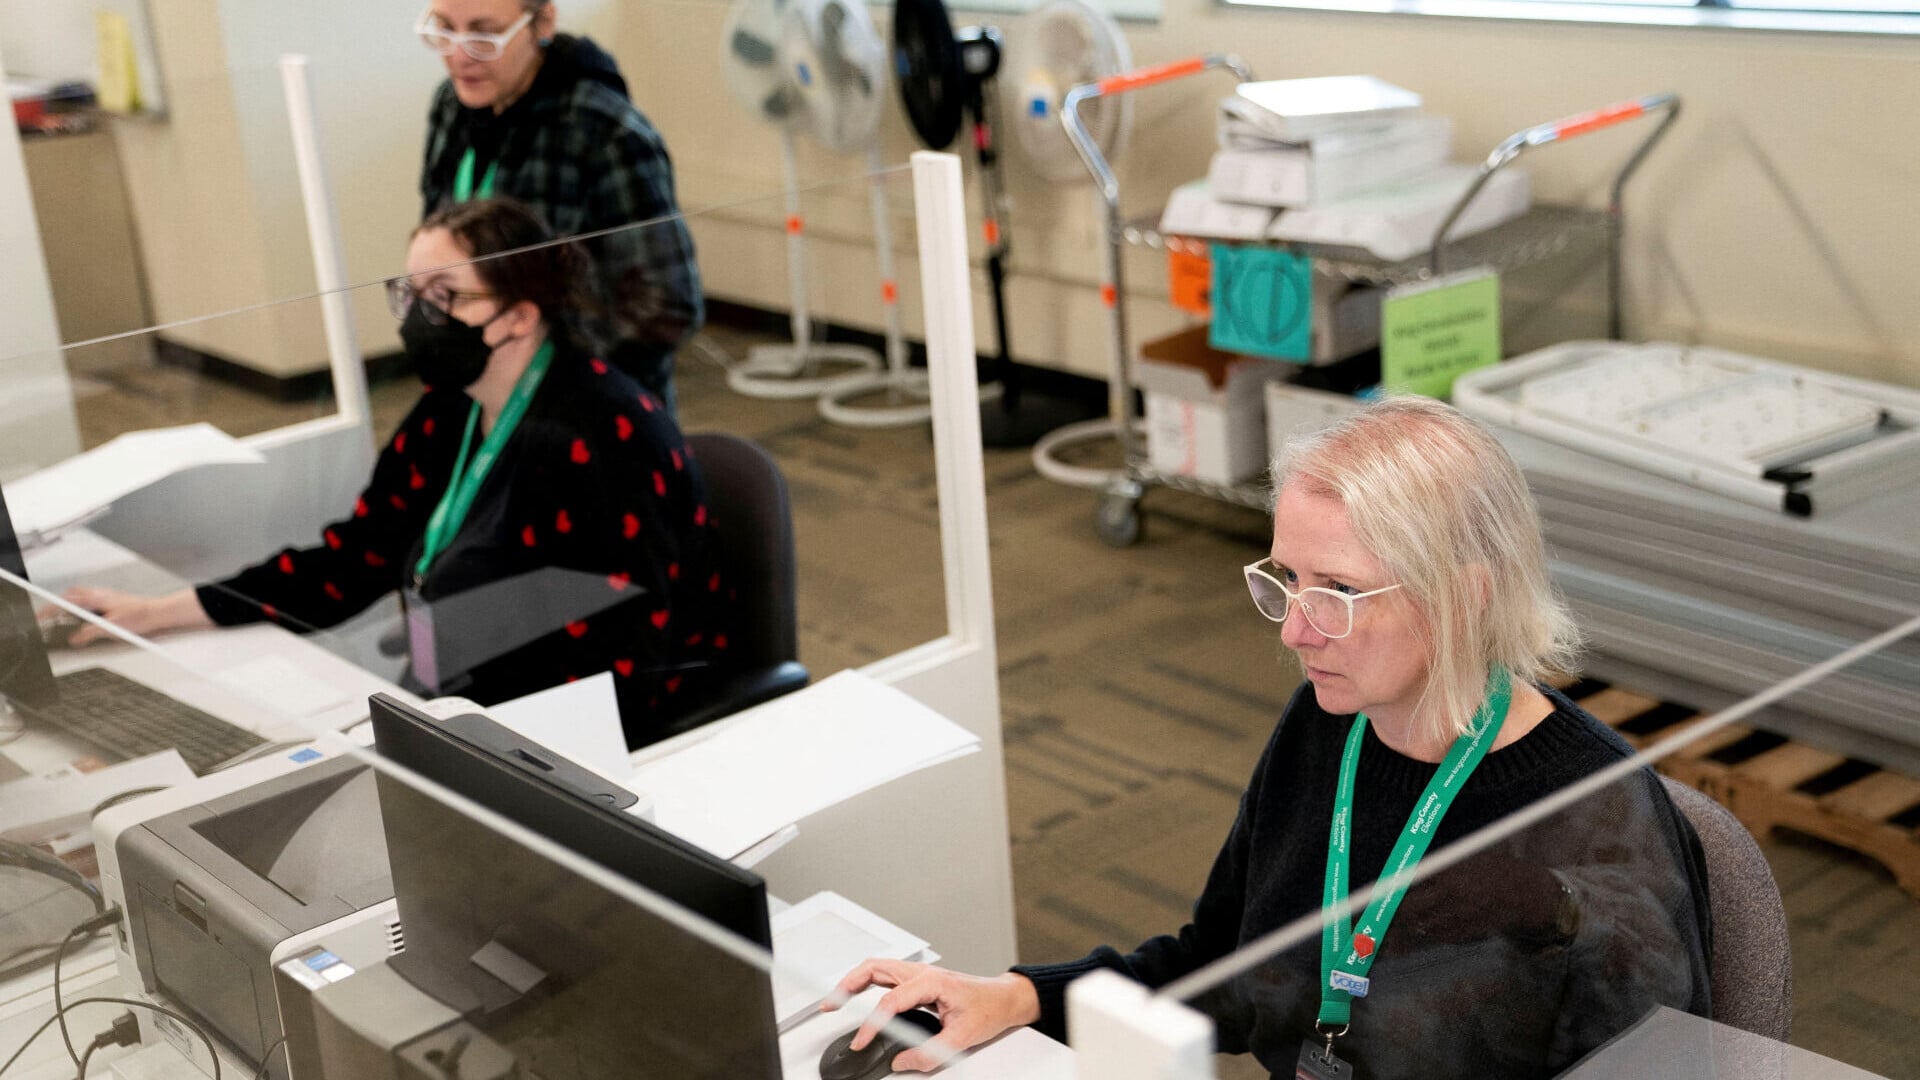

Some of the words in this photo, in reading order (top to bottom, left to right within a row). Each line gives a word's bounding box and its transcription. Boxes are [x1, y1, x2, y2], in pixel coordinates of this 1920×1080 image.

[1410, 817, 1425, 834] King
[1419, 792, 1438, 818] County
[1421, 803, 1442, 833] Elections
